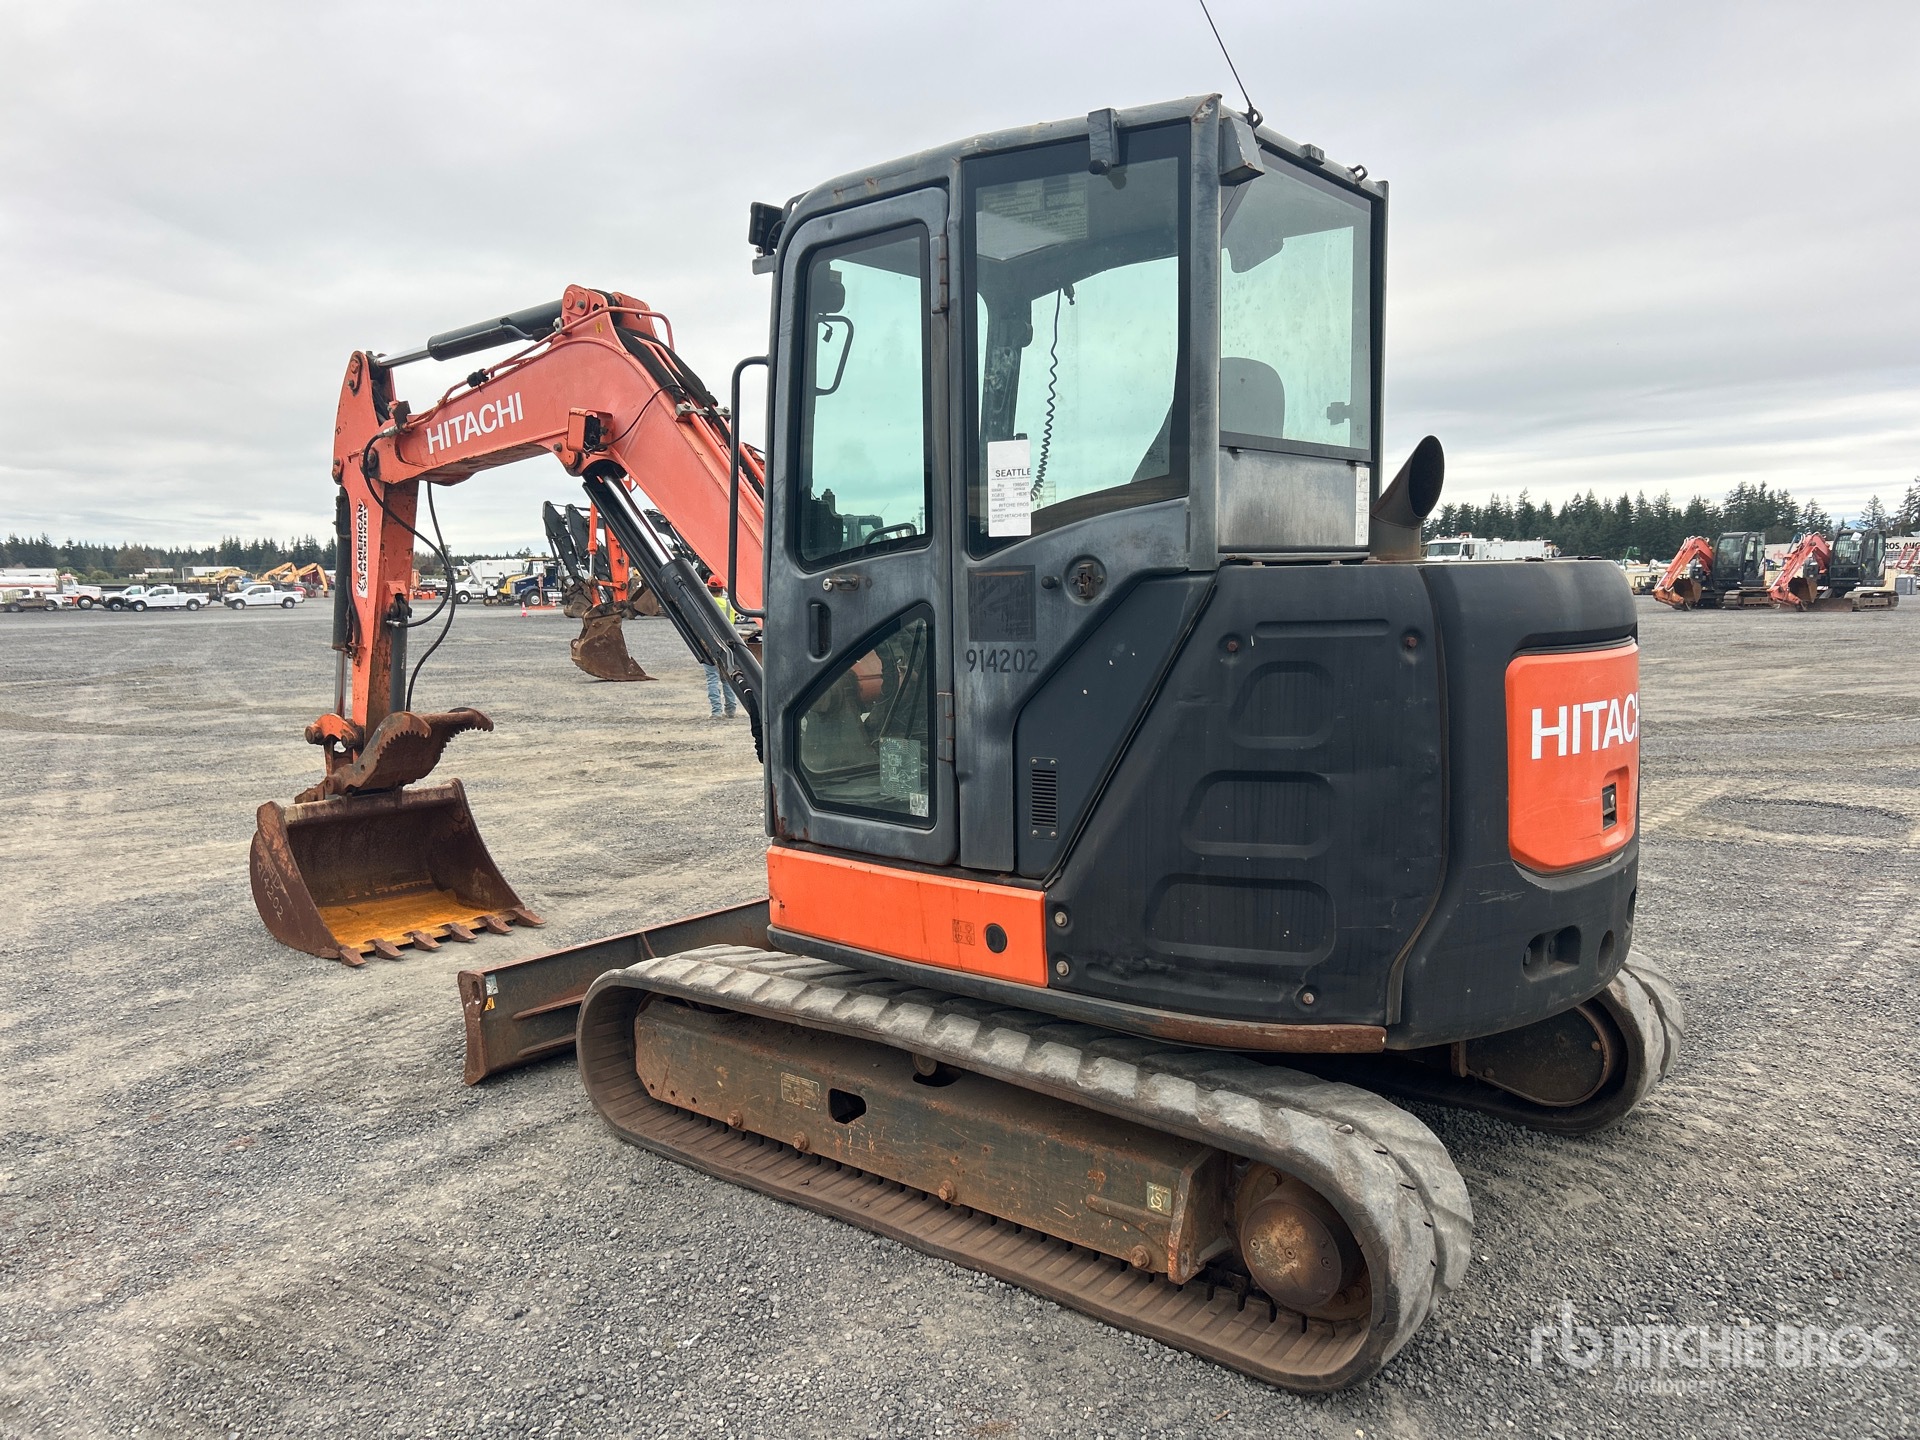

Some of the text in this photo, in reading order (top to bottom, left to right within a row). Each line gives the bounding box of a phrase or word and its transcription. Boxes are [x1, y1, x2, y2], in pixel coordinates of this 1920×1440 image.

[426, 391, 524, 454] HITACHI
[995, 468, 1030, 478] SEATTLE
[966, 649, 1039, 673] 914202
